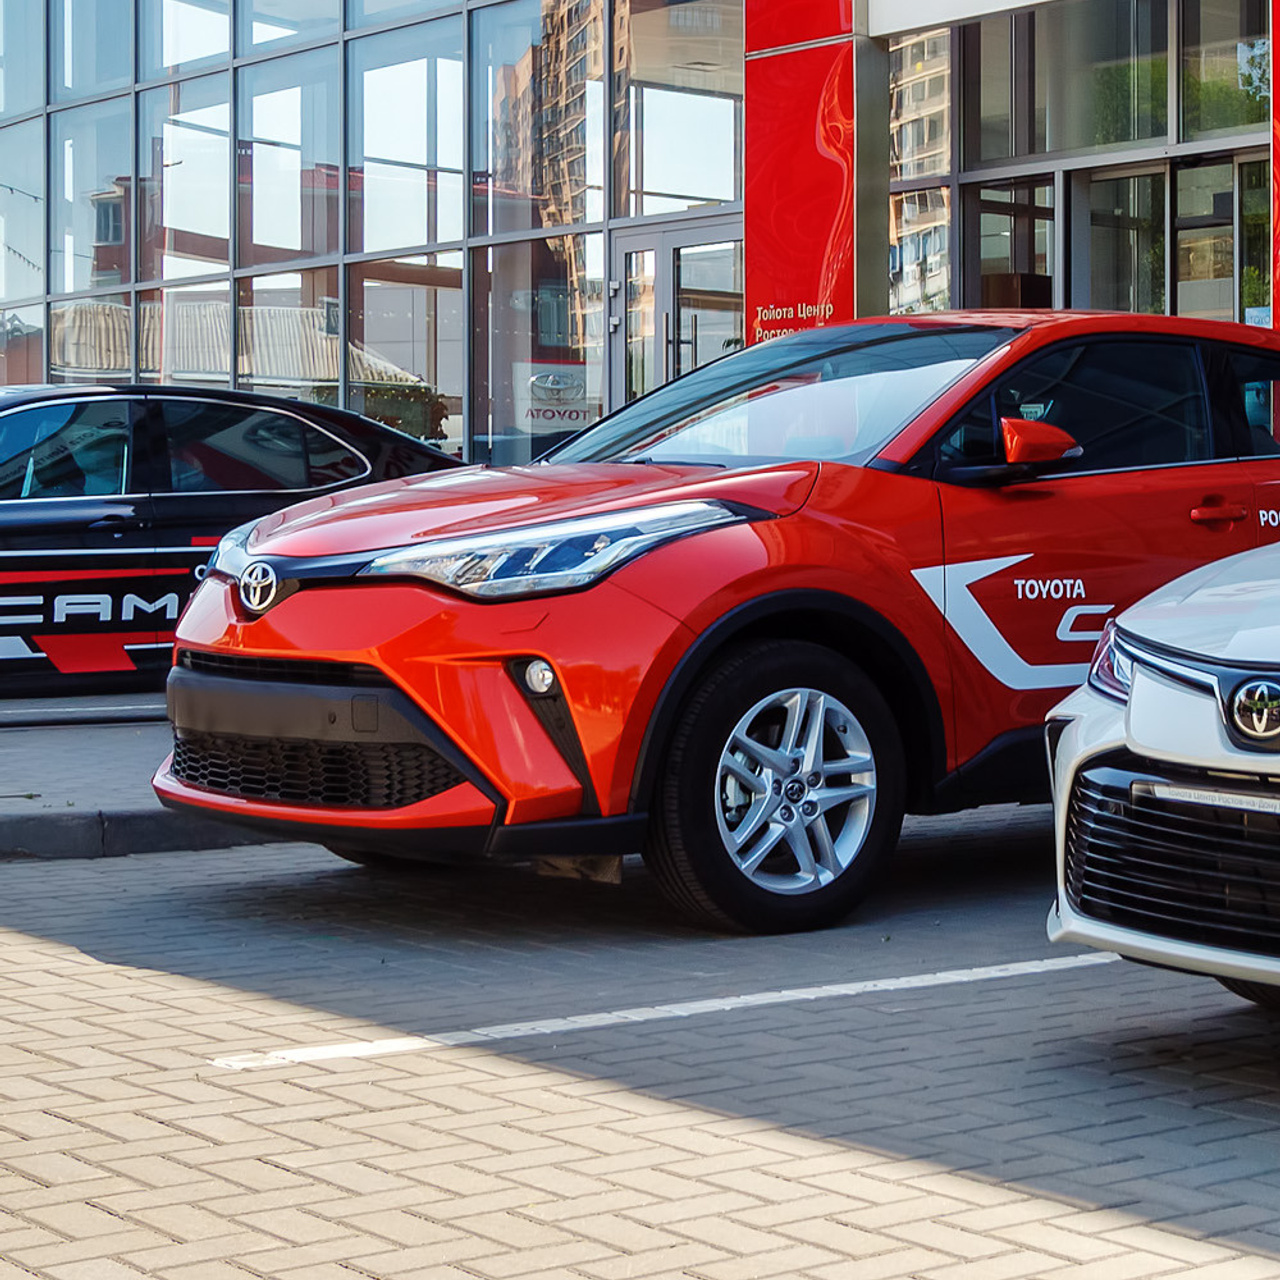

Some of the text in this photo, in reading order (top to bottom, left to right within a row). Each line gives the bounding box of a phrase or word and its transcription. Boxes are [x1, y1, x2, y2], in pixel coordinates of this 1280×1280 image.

[756, 302, 834, 321] Тойота Центр
[1014, 579, 1086, 599] TOYOTA
